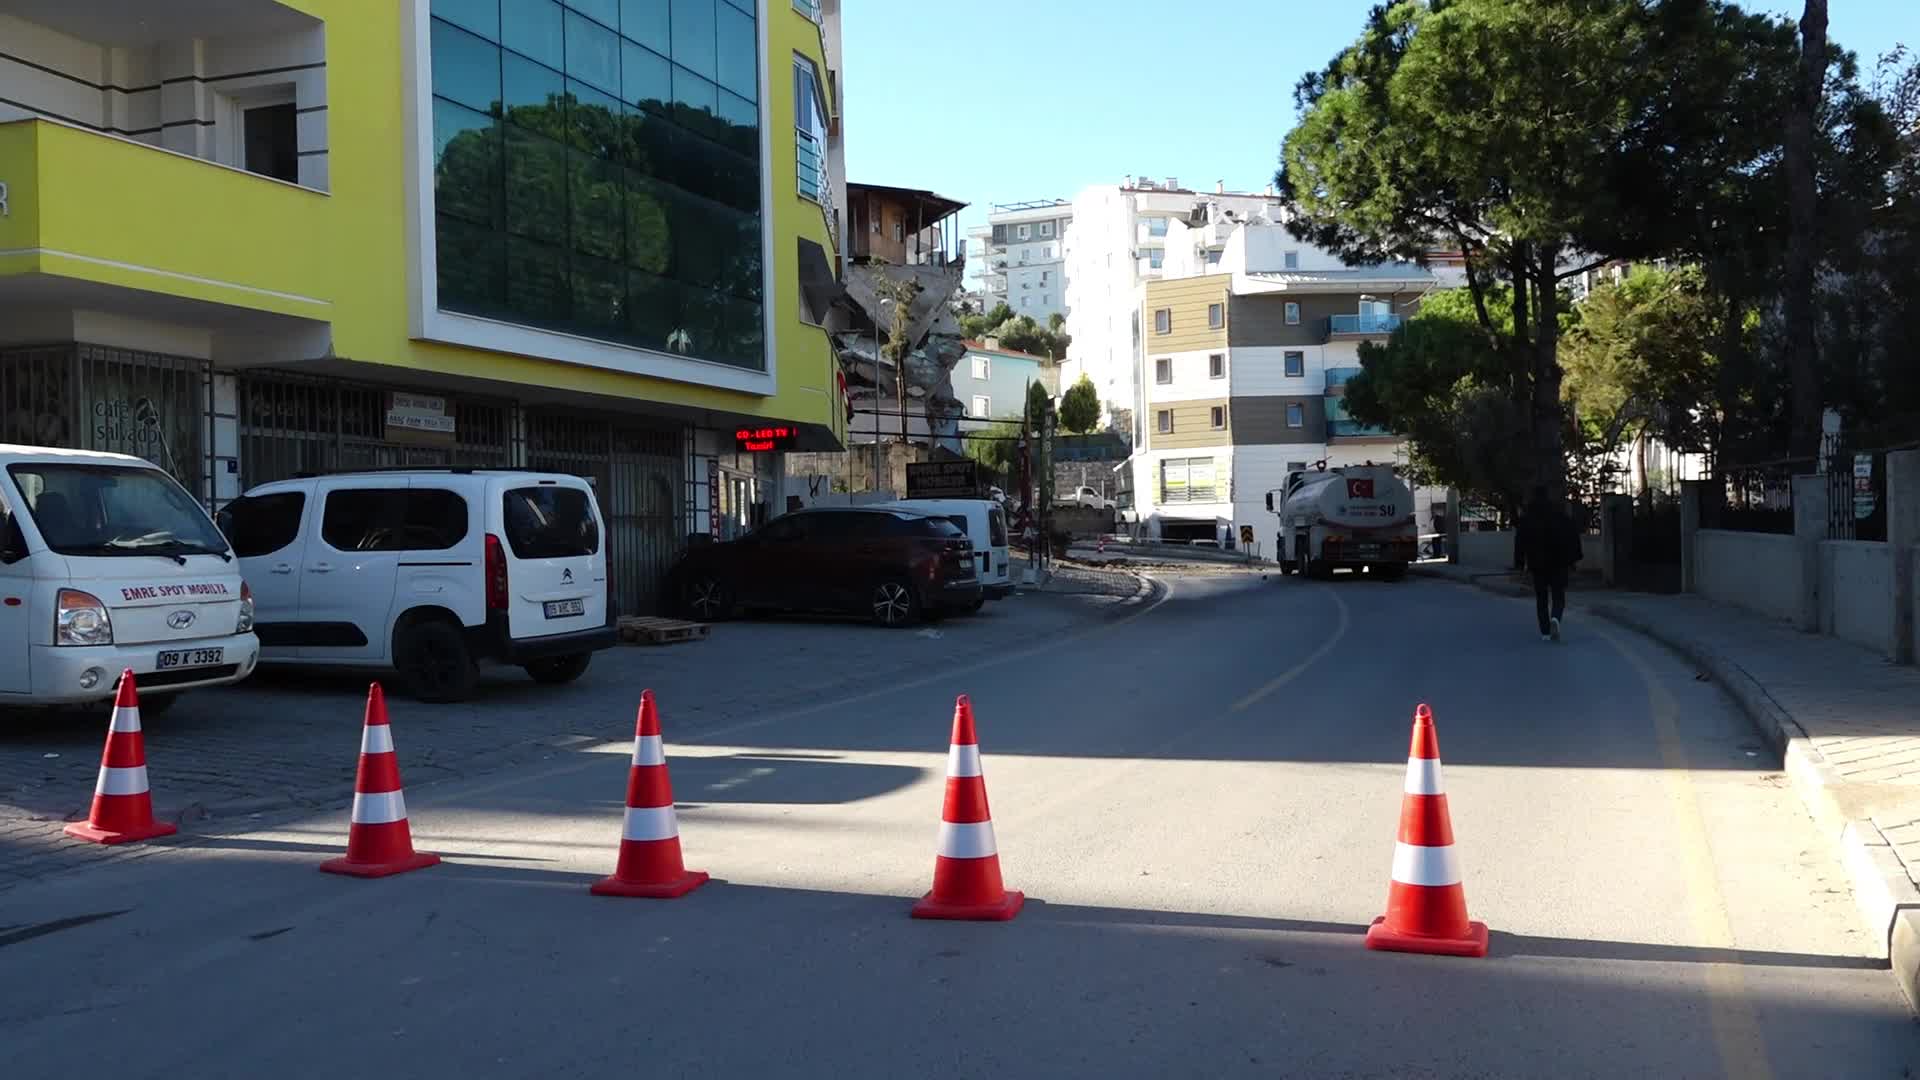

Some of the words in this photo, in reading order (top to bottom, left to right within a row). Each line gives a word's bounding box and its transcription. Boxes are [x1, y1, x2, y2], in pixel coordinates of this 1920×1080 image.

[121, 586, 157, 601] EMRE
[158, 584, 186, 597] SPOT
[164, 653, 178, 666] 09
[182, 652, 191, 665] K
[194, 650, 222, 664] 3392
